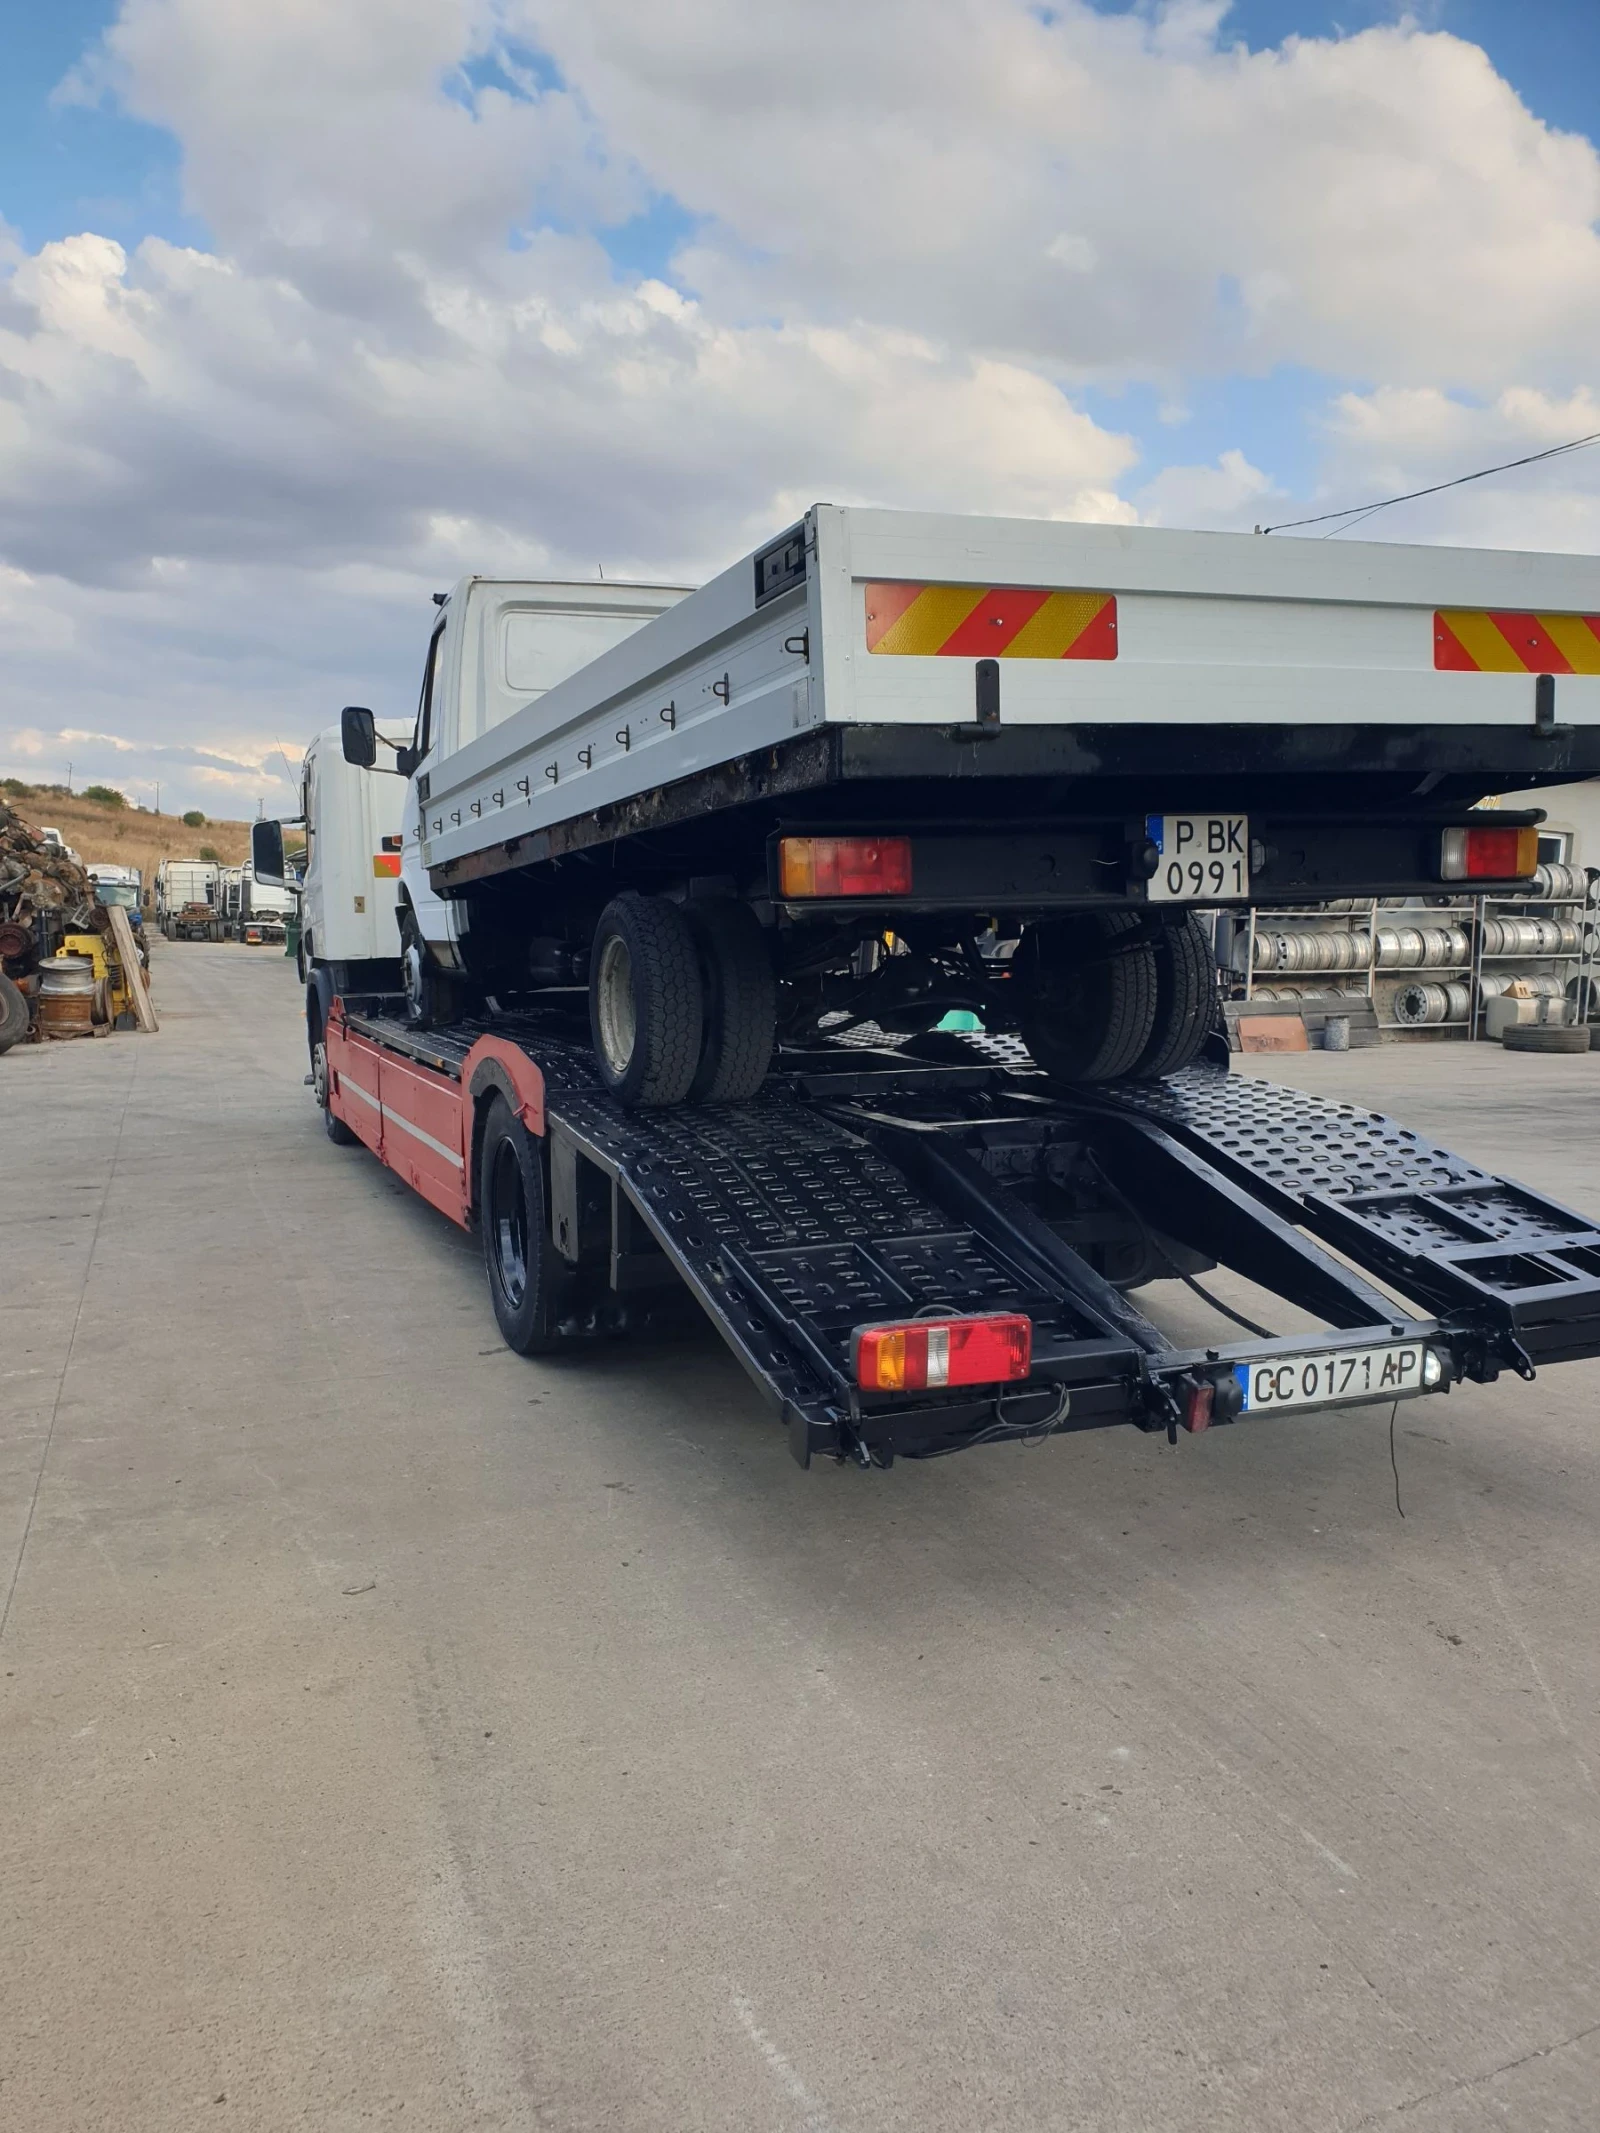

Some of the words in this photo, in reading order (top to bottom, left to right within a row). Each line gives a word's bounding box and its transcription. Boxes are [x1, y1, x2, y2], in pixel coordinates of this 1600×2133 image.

[1176, 820, 1194, 854] P
[1207, 820, 1245, 853] BK
[1167, 860, 1242, 895] 0991
